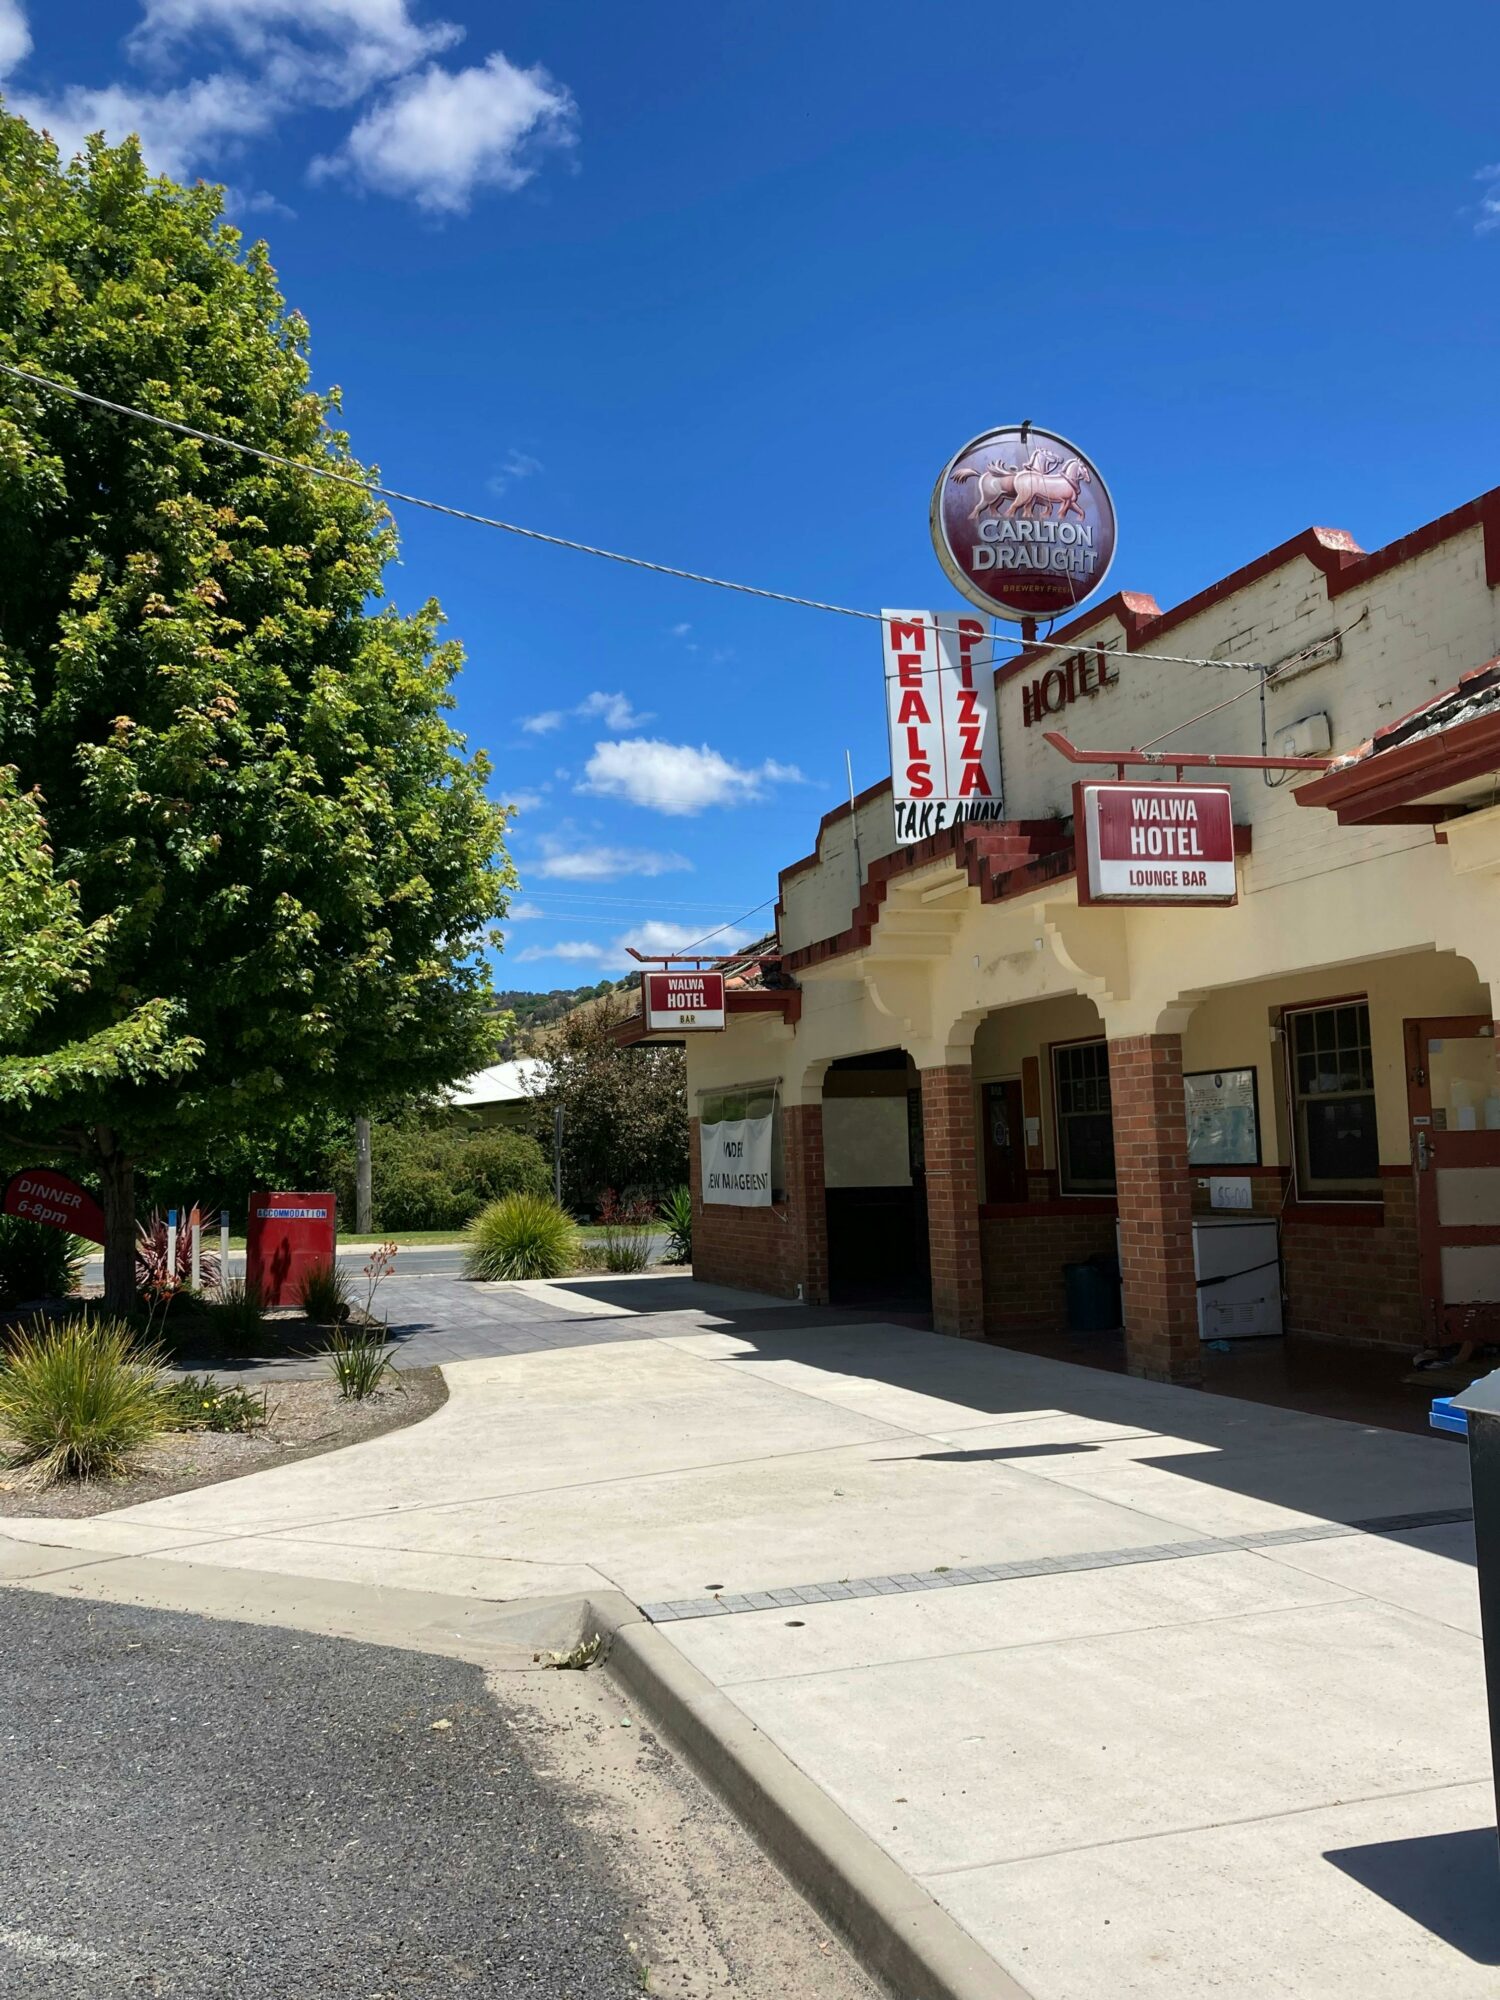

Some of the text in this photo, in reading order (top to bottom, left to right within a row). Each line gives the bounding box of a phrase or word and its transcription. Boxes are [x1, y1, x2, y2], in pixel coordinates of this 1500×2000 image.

[978, 519, 1094, 548] CARLTON
[972, 545, 1098, 574] DRAUGHT
[1003, 584, 1045, 593] BREWERY
[1022, 641, 1119, 728] HOTEL
[890, 617, 933, 798] MEALS
[957, 619, 992, 796] PIZZA
[895, 801, 946, 838] TAKE
[1131, 798, 1198, 821] WALWA
[1130, 826, 1204, 856] HOTEL
[1129, 870, 1207, 887] LOUNGE BAR
[668, 978, 705, 991] WALWA
[667, 993, 707, 1008] HOTEL
[679, 1014, 696, 1024] BAR
[708, 1173, 768, 1190] EW MAAGEENT
[18, 1180, 82, 1208] DINNER
[18, 1200, 68, 1224] 6-8pm
[257, 1209, 327, 1218] ACCOMMODATION
